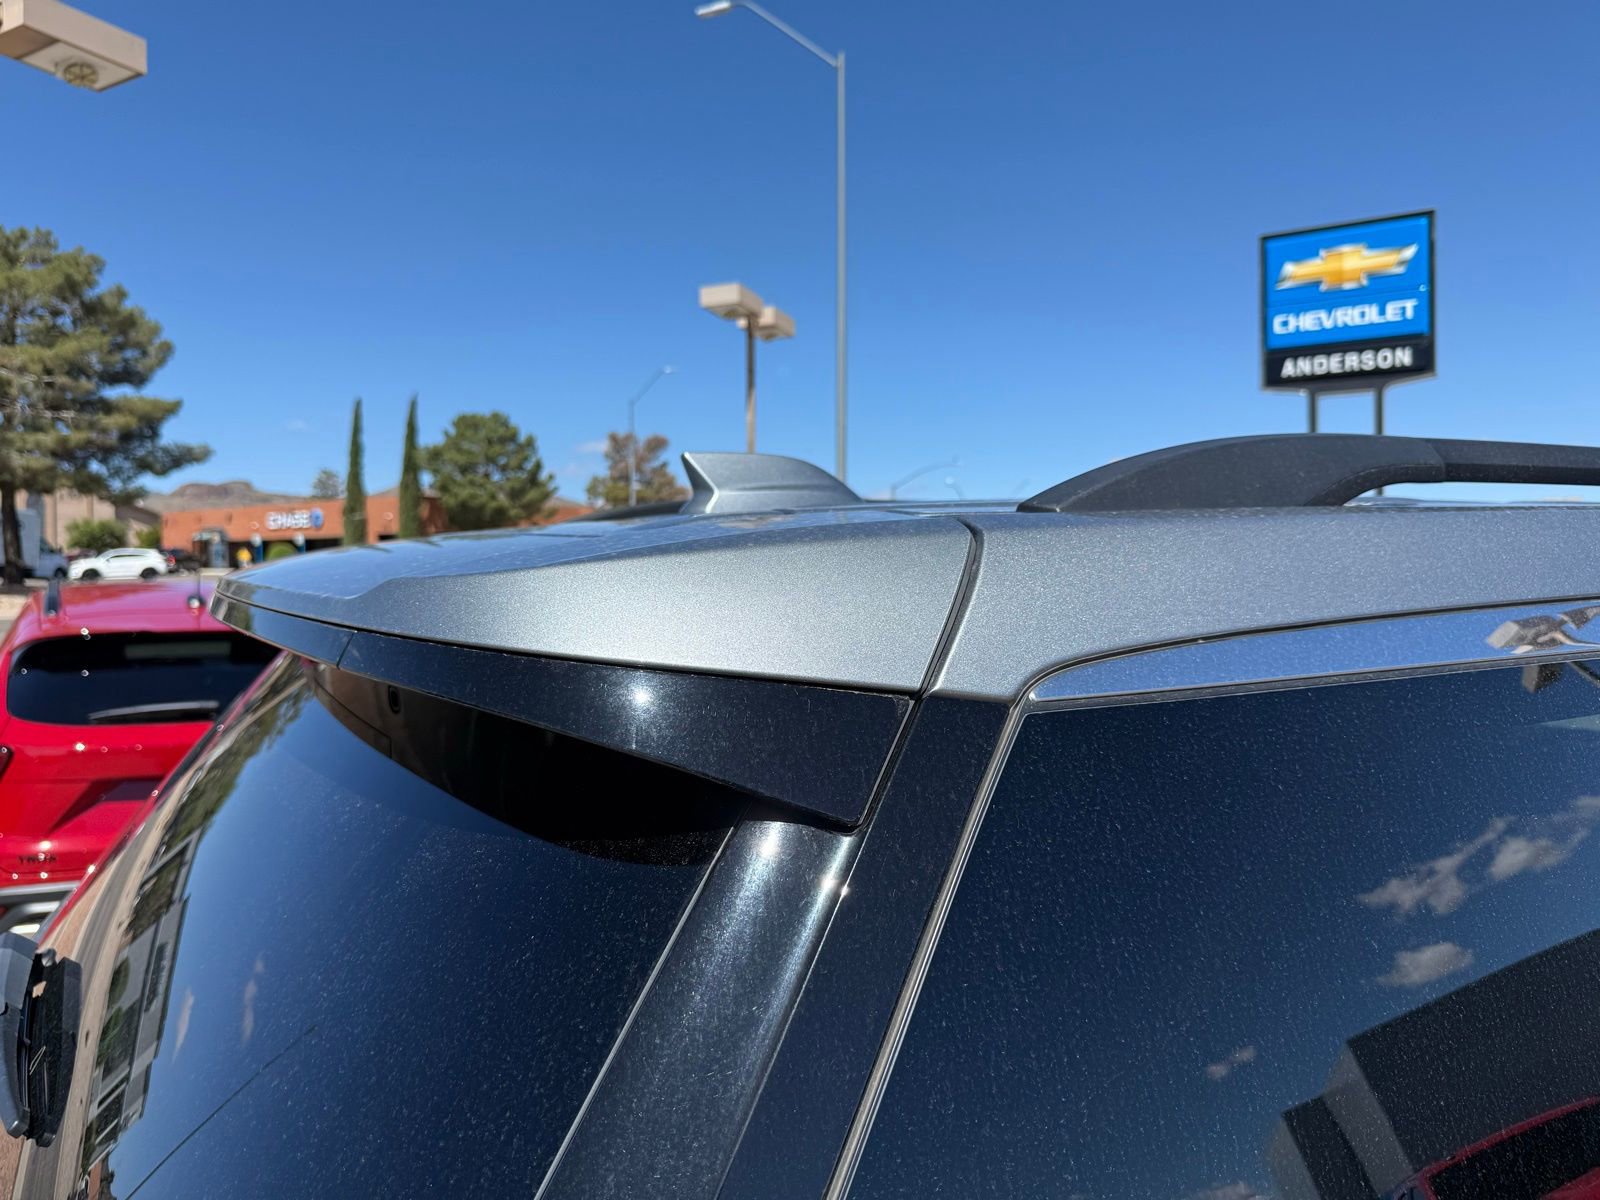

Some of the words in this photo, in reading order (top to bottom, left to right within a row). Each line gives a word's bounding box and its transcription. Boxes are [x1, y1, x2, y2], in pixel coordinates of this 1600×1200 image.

[1273, 299, 1418, 334] CHEVROLET
[1280, 346, 1413, 378] ANDERSON
[266, 510, 311, 530] CHASE
